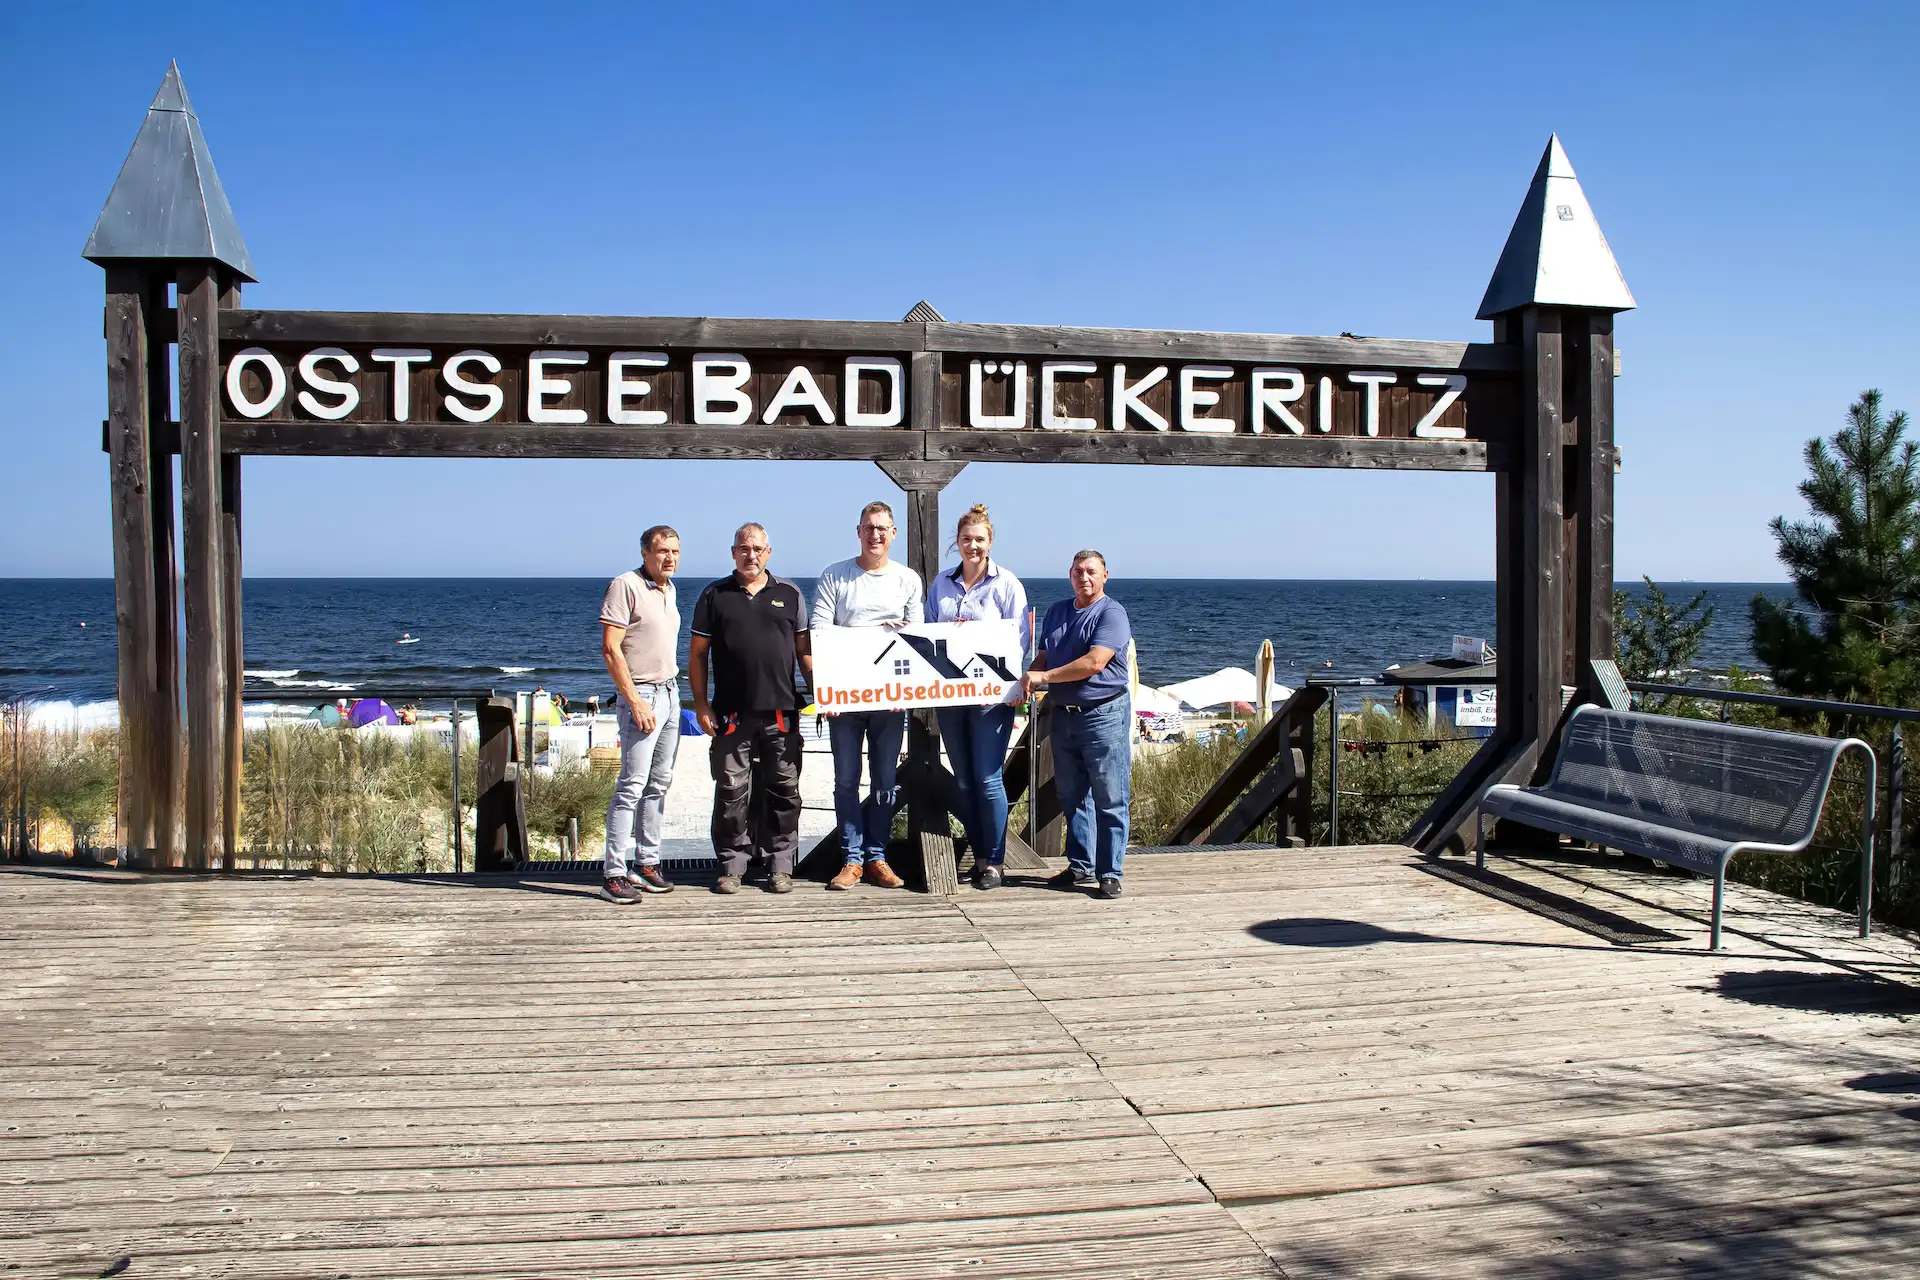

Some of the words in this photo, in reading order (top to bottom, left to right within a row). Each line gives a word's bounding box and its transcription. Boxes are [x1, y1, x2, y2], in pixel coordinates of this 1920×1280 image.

[226, 346, 906, 427] OSTSEEBAD
[969, 359, 1467, 439] ÜCKERITZ
[816, 679, 1002, 706] UnserUsedom.de
